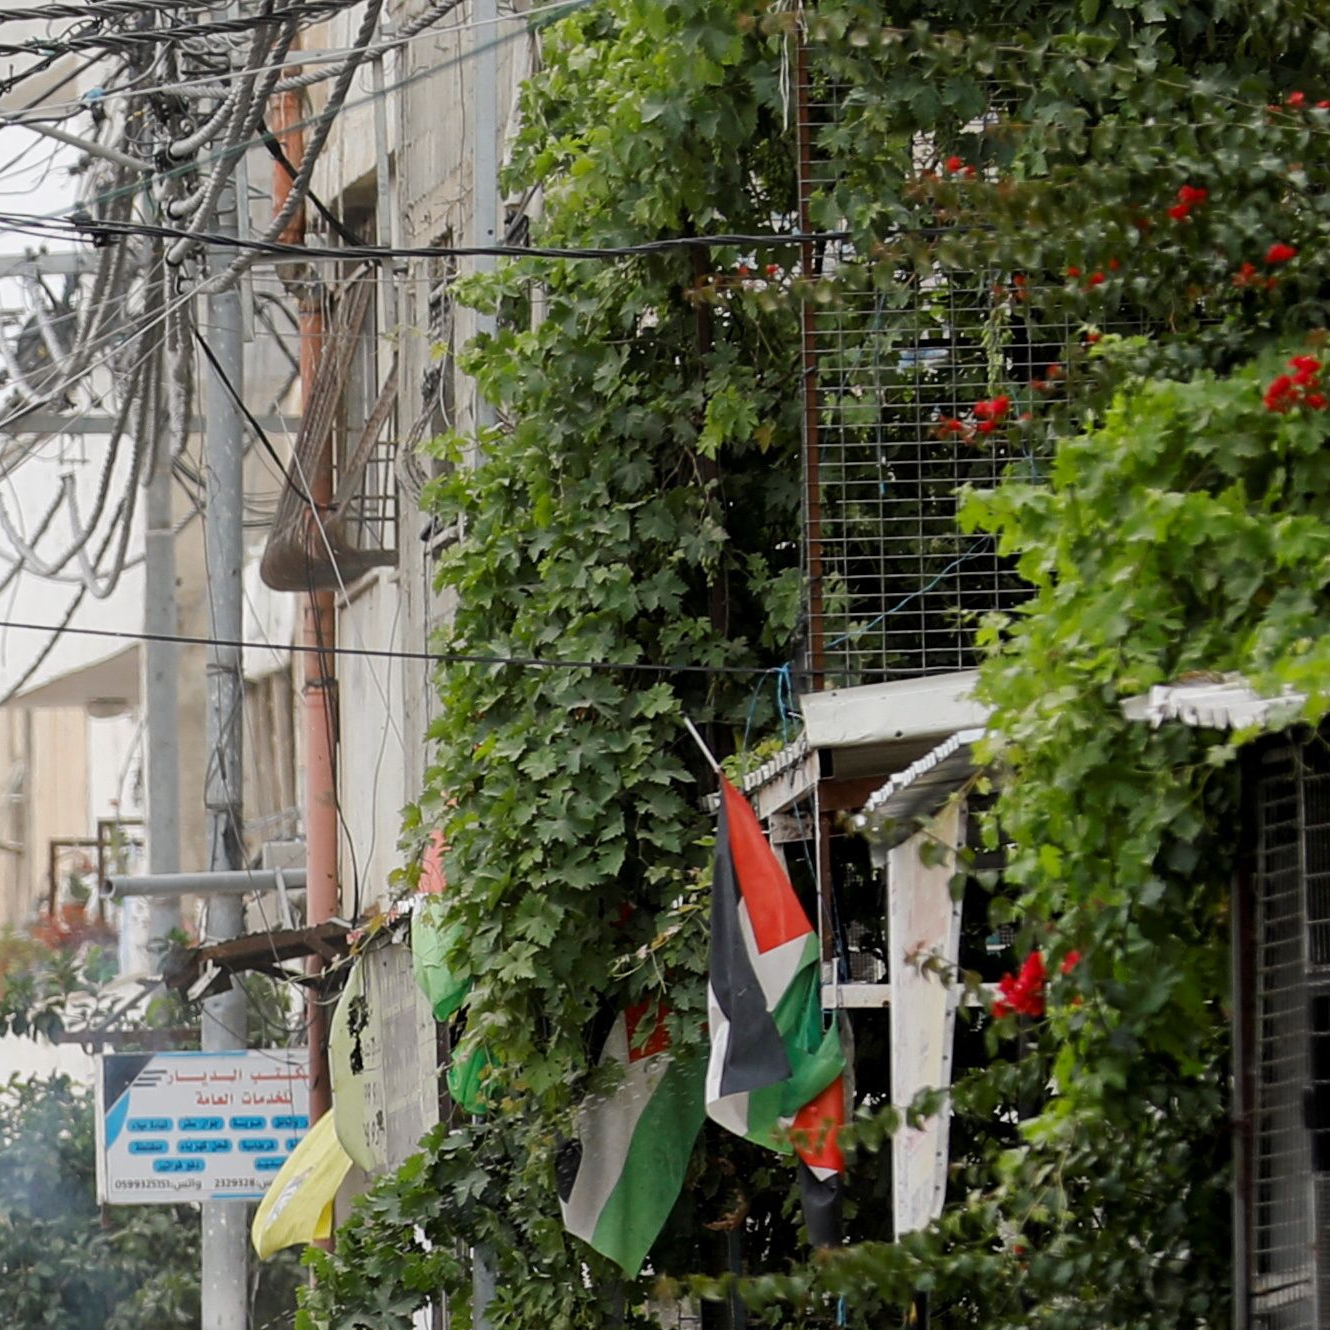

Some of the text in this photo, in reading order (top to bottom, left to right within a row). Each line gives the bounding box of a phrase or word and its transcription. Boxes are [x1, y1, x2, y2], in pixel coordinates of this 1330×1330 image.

[166, 1065, 309, 1087] كتب الديار
[195, 1091, 233, 1106] العامة
